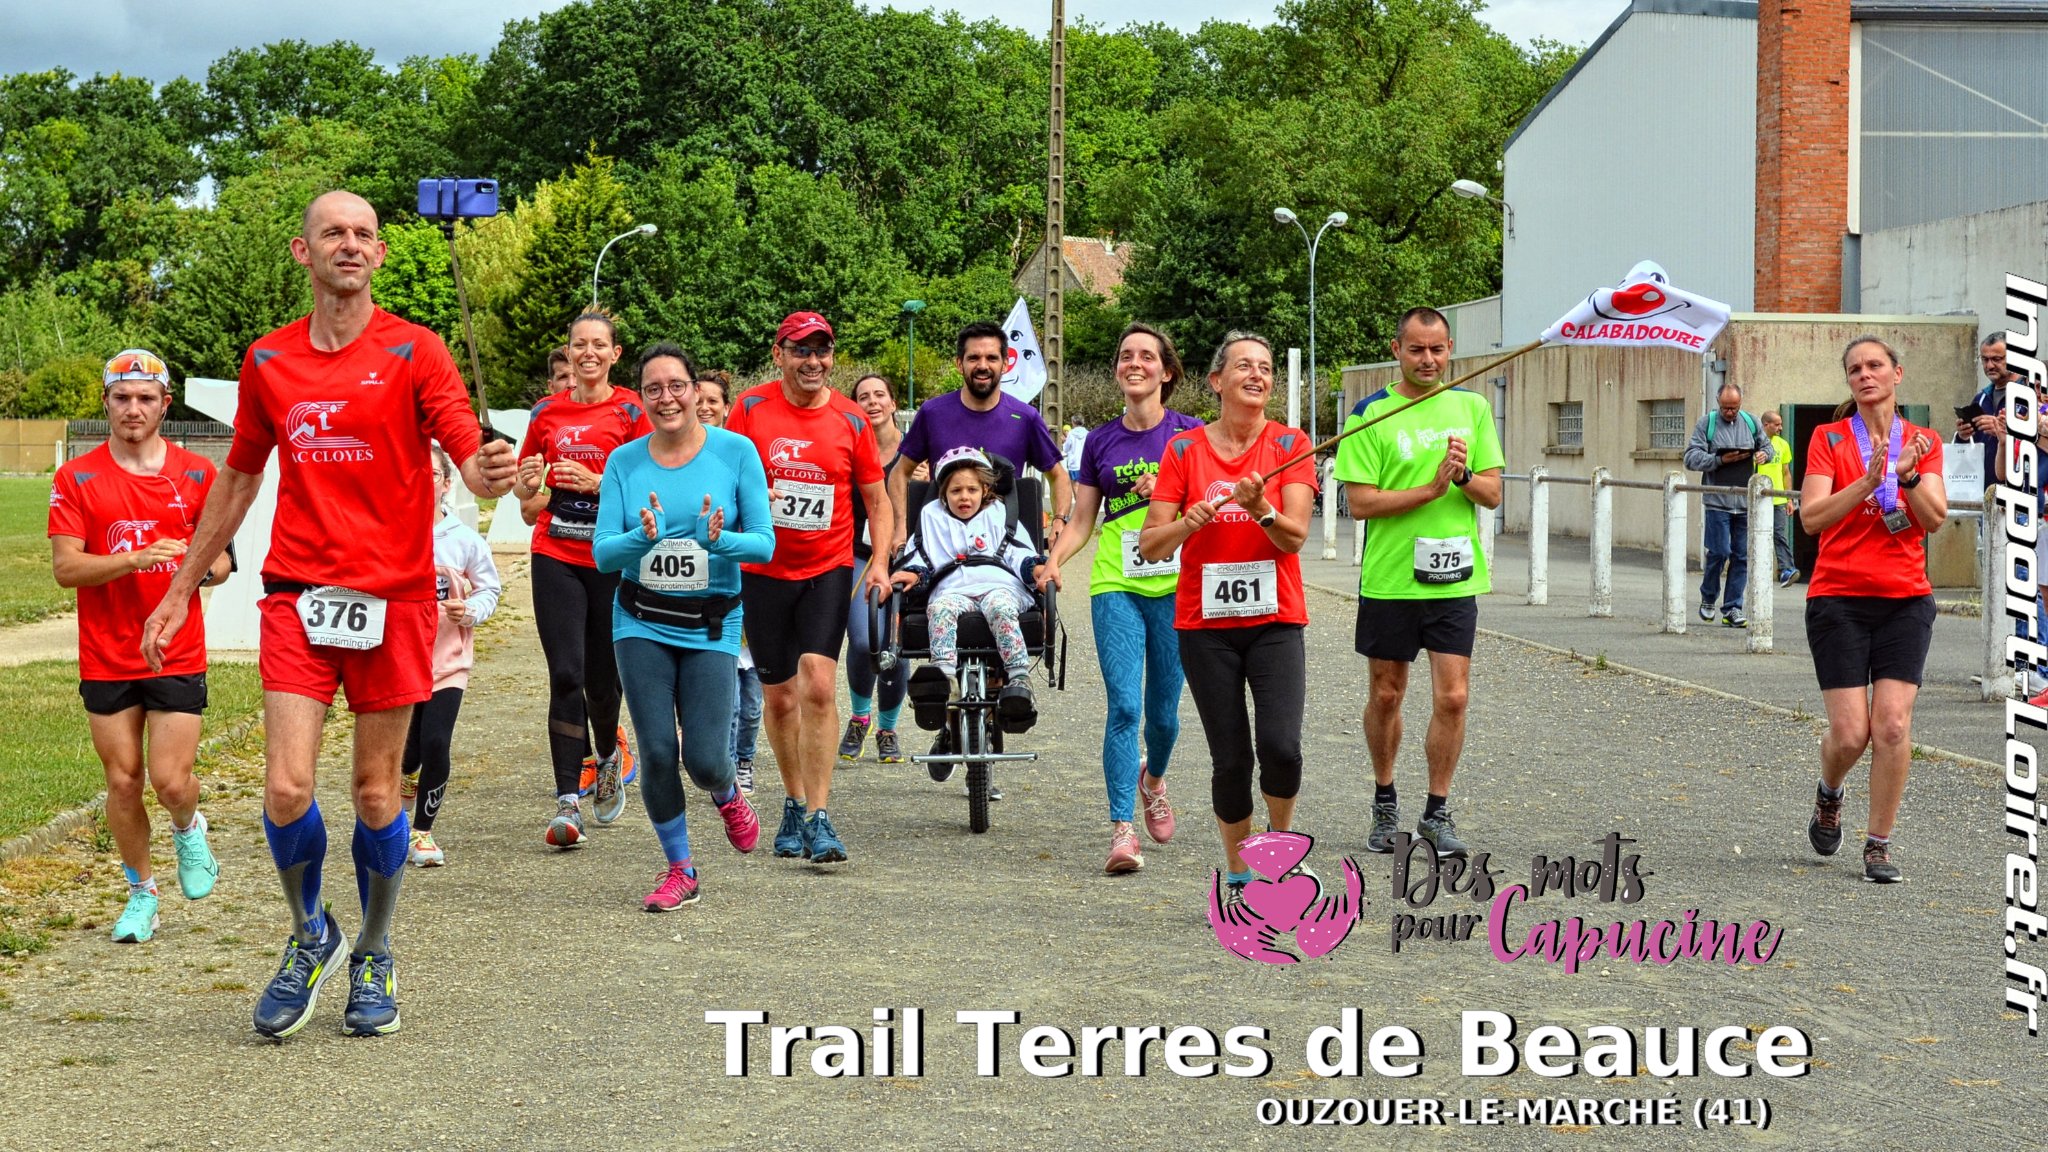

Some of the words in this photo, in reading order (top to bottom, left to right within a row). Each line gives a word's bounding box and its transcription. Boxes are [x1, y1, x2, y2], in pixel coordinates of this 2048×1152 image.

[1561, 321, 1706, 348] CALABADOURE
[312, 449, 374, 462] CLOYES
[569, 452, 605, 460] CLOYES
[767, 467, 782, 477] AC
[784, 468, 828, 481] CLOYES
[782, 495, 825, 518] 374
[557, 526, 591, 537] PROTIMING
[658, 540, 693, 549] OTIMING
[131, 561, 179, 573] LOYES
[649, 554, 696, 578] 405
[1429, 551, 1461, 570] 375
[1217, 562, 1260, 573] PROTIMING
[1427, 571, 1462, 580] PROTIMING
[1214, 578, 1261, 604] 461
[306, 599, 368, 632] 376
[1207, 605, 1273, 618] www.protiming.fr
[309, 635, 374, 650] w.protiming.fr
